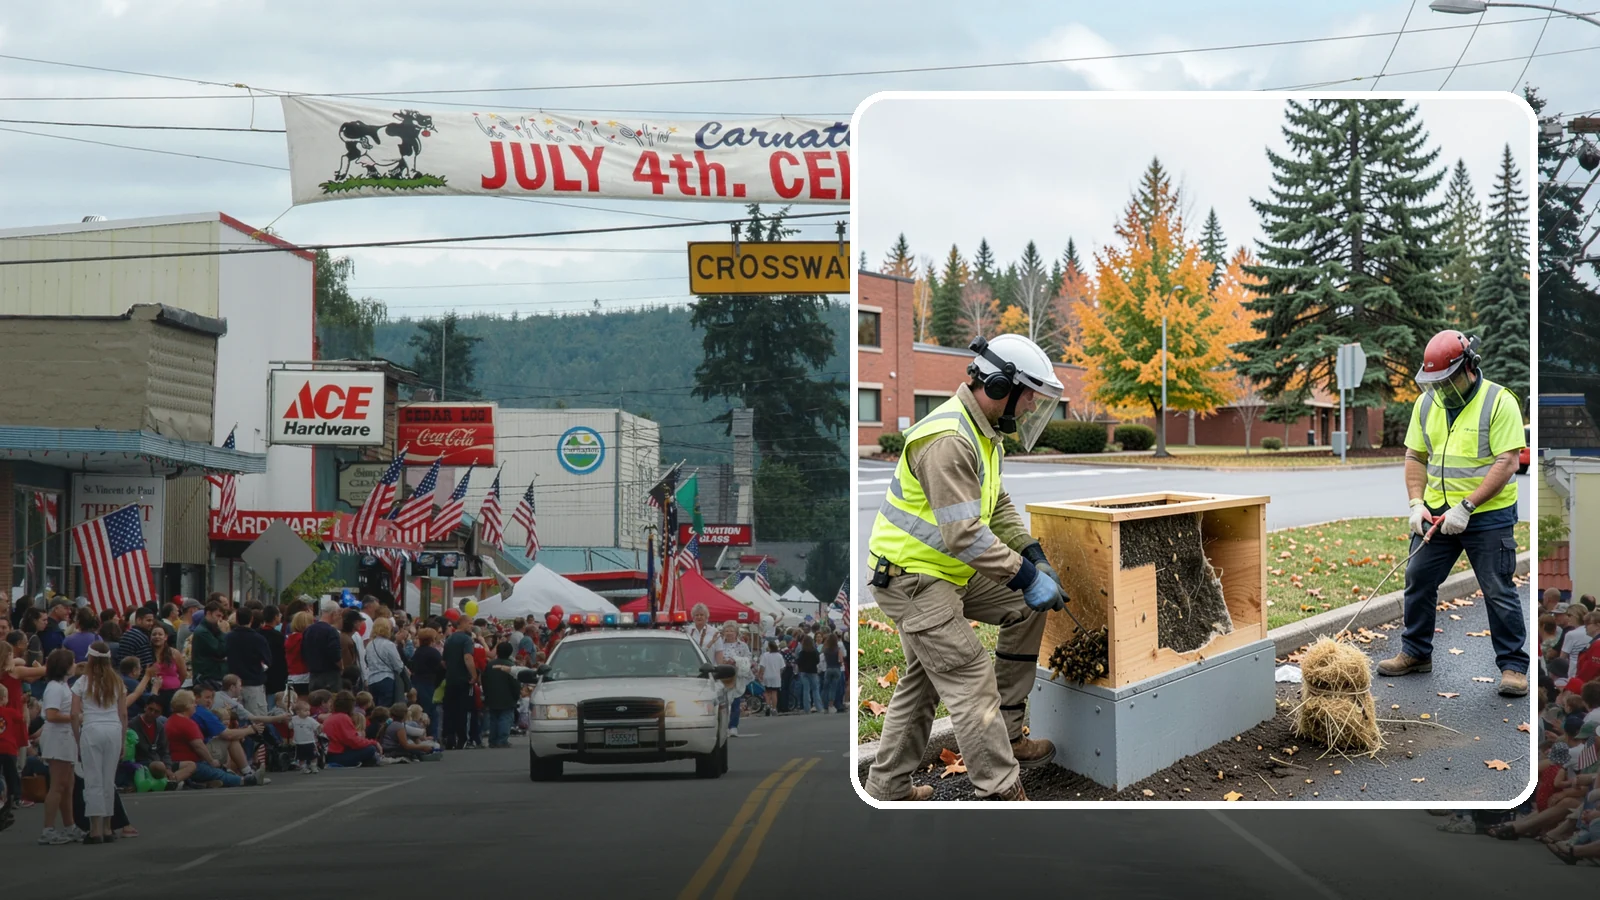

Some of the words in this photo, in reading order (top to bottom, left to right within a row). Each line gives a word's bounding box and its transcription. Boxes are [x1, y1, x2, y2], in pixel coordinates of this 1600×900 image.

[481, 141, 605, 192] JULY
[632, 150, 746, 198] 4th.
[697, 254, 850, 280] CROSSWA
[283, 380, 374, 420] ACE
[405, 409, 453, 422] CEDAR
[461, 409, 485, 422] LOG
[284, 421, 371, 436] Hardware
[95, 485, 124, 494] Vincent
[126, 486, 135, 495] de
[137, 486, 155, 495] Paul
[699, 535, 730, 543] GLASS
